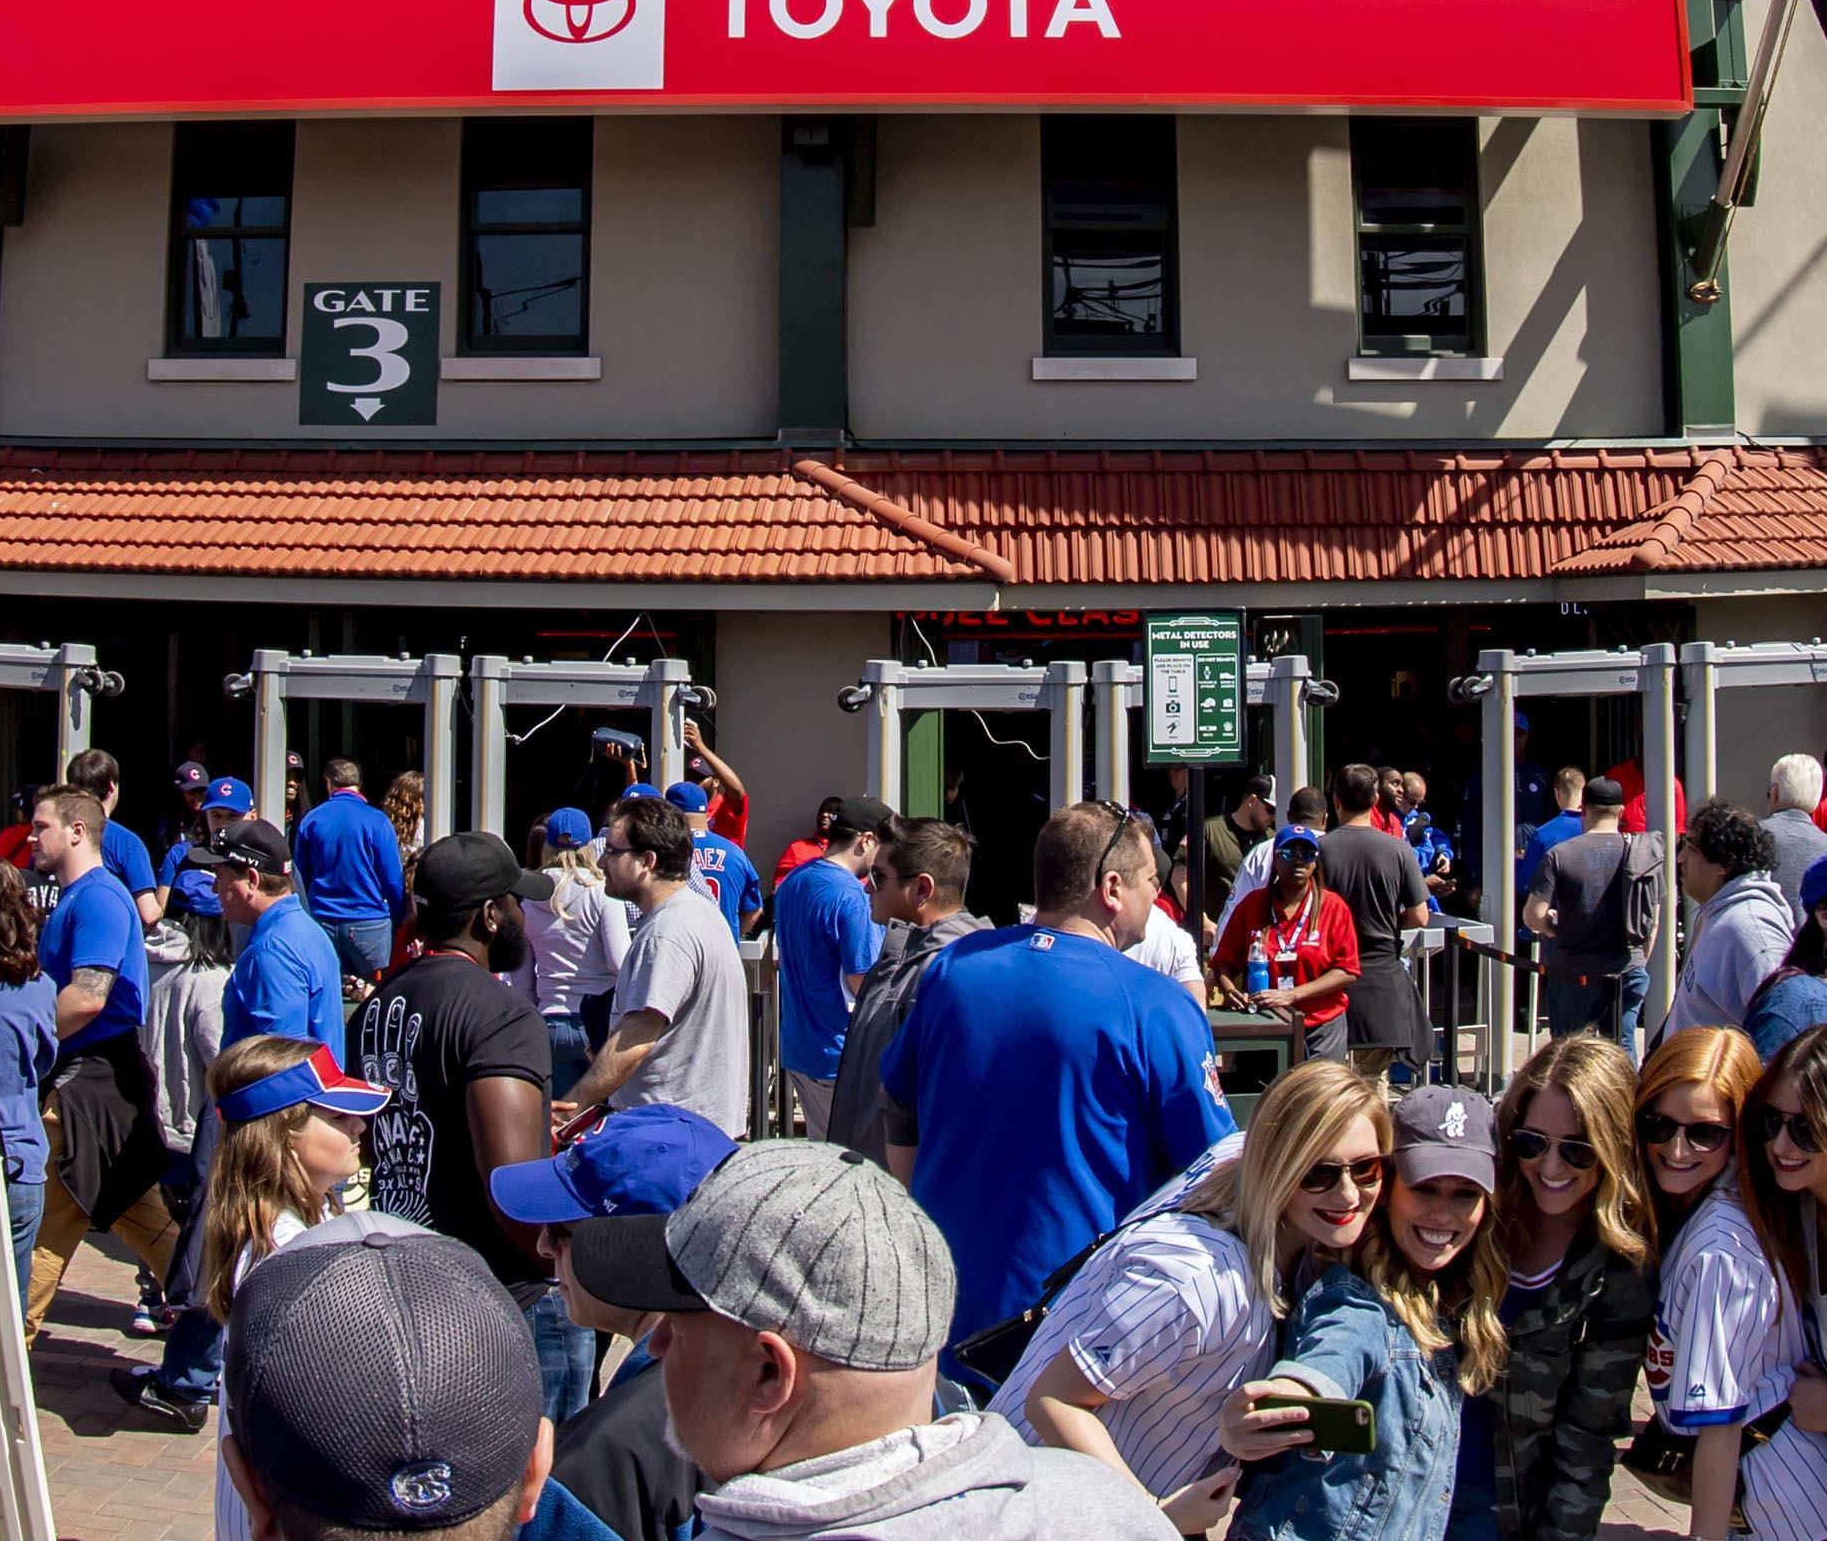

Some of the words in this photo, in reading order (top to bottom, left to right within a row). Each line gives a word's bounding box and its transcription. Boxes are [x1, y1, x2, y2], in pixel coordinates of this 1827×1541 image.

[313, 289, 431, 314] GATE
[325, 316, 411, 394] 3
[1152, 631, 1182, 640] METAL
[1184, 630, 1237, 640] DETECTORS
[1180, 641, 1190, 649] IN
[1192, 641, 1210, 649] USE
[693, 848, 727, 872] AEZ
